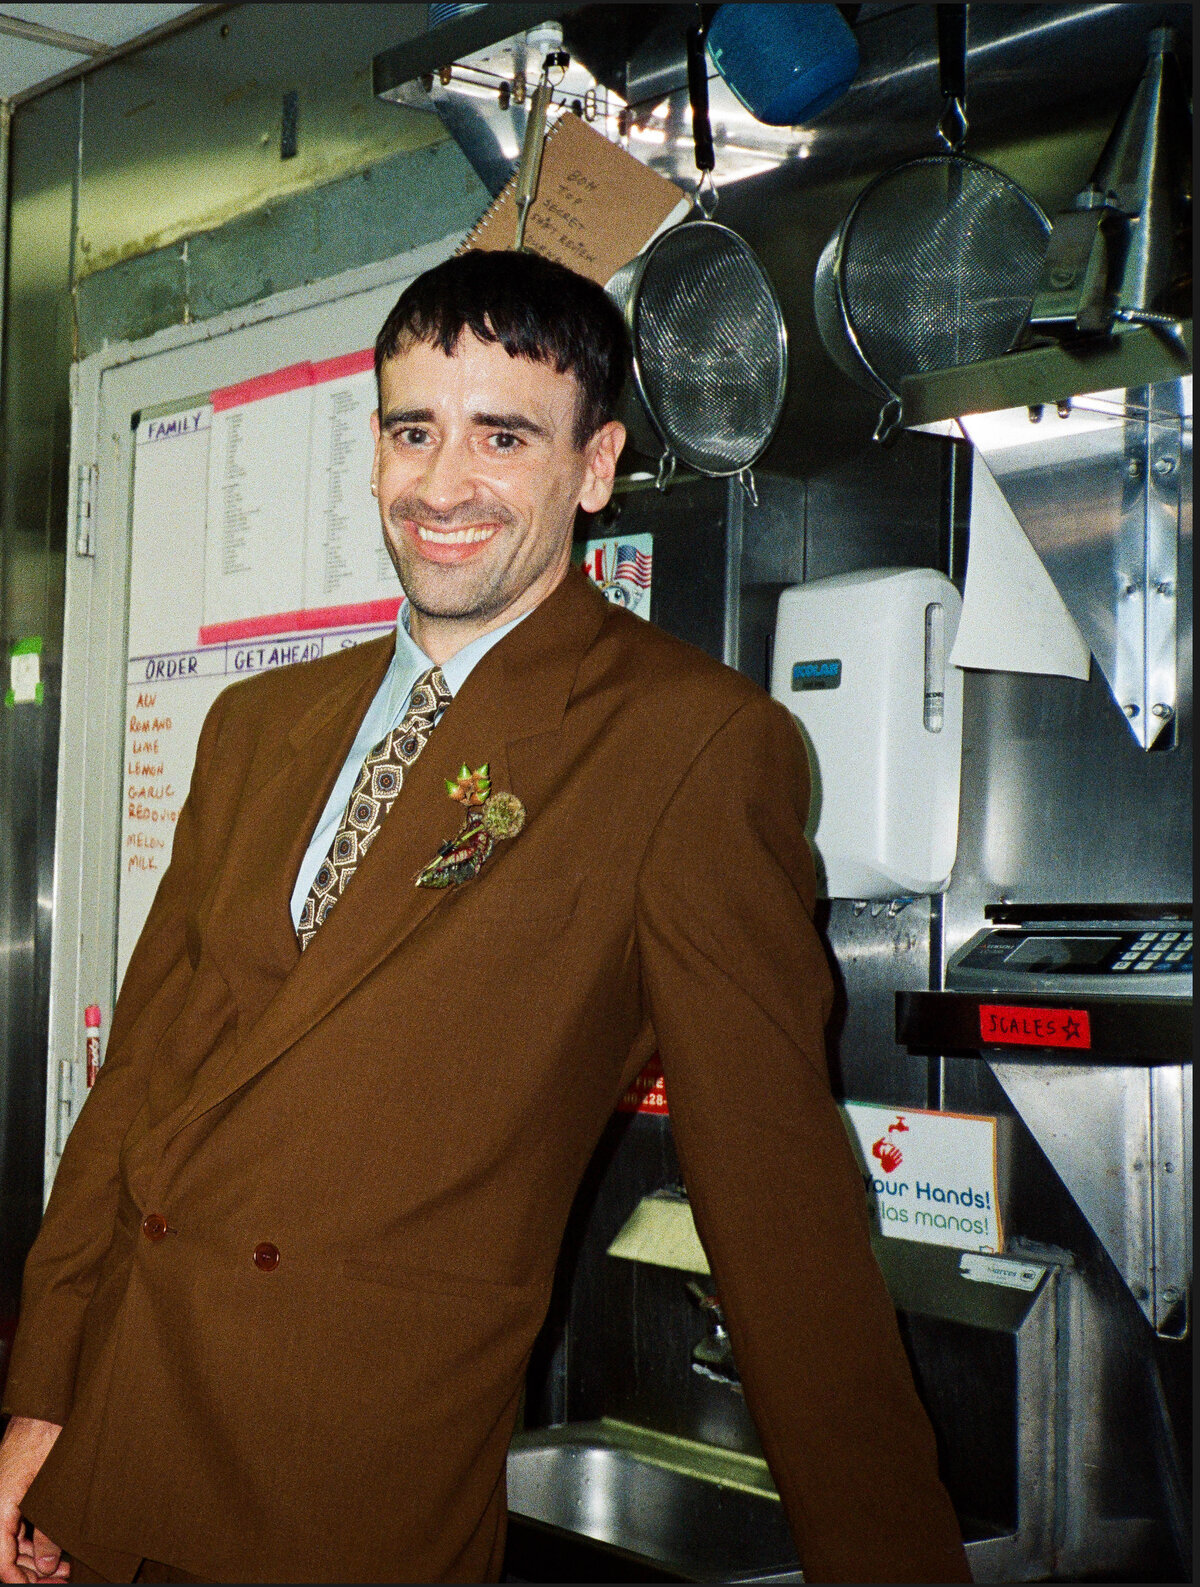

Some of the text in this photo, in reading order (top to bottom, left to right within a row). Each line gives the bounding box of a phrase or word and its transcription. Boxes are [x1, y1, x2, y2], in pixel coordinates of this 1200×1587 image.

[543, 200, 585, 230] SECRET
[147, 411, 201, 439] FAMILY
[145, 656, 198, 680] ORDER
[128, 760, 164, 777] LEMON
[127, 855, 158, 873] MILK
[989, 1013, 1057, 1038] SCALES
[916, 1181, 992, 1211] Hands!
[882, 1201, 909, 1223] las
[915, 1211, 989, 1236] manos!
